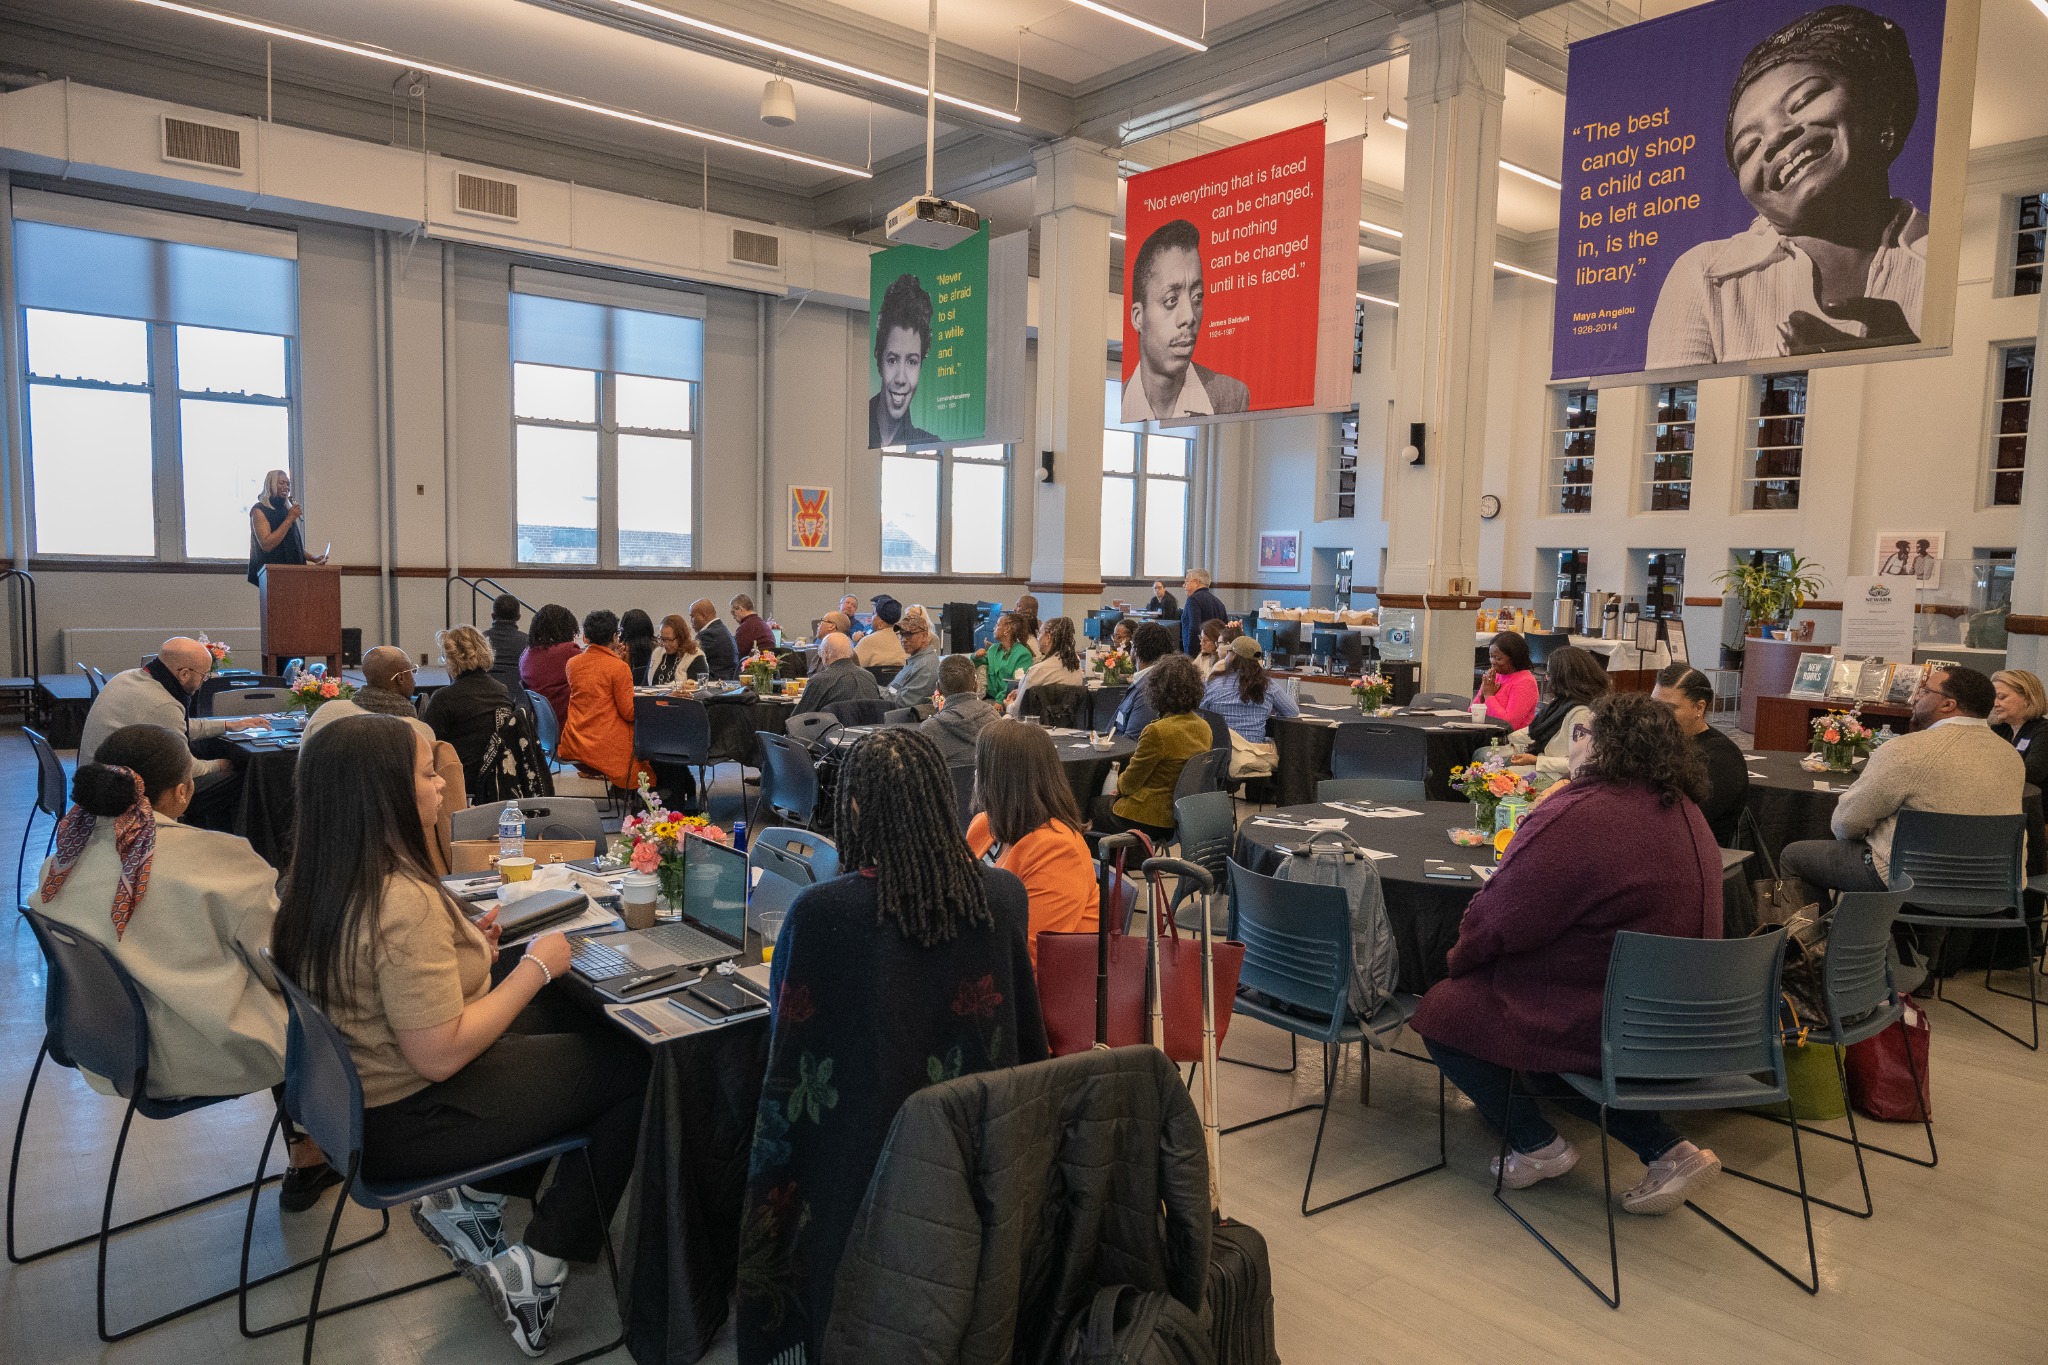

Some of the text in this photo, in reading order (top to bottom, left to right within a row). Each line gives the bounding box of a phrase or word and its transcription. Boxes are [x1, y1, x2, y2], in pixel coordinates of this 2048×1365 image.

[1573, 107, 1670, 142] “The best
[1582, 134, 1696, 171] candy shop
[1144, 157, 1306, 212] “Not everything that is faced
[1581, 166, 1685, 200] a child can
[1212, 182, 1314, 220] can be changed,
[1580, 193, 1700, 228] be left alone
[1211, 218, 1277, 245] but nothing
[1578, 230, 1658, 257] in, is the
[1211, 235, 1308, 269] can be changed
[1211, 262, 1305, 293] until it is faced.”
[1576, 258, 1646, 285] library.”
[938, 285, 972, 304] be afraid
[938, 308, 956, 322] to sit
[1573, 306, 1635, 322] Maya Angelou
[938, 325, 965, 341] a while
[1573, 323, 1617, 335] 1928-2014
[938, 345, 953, 359] and
[1802, 671, 1822, 682] BOOKS
[1807, 663, 1822, 672] NEW
